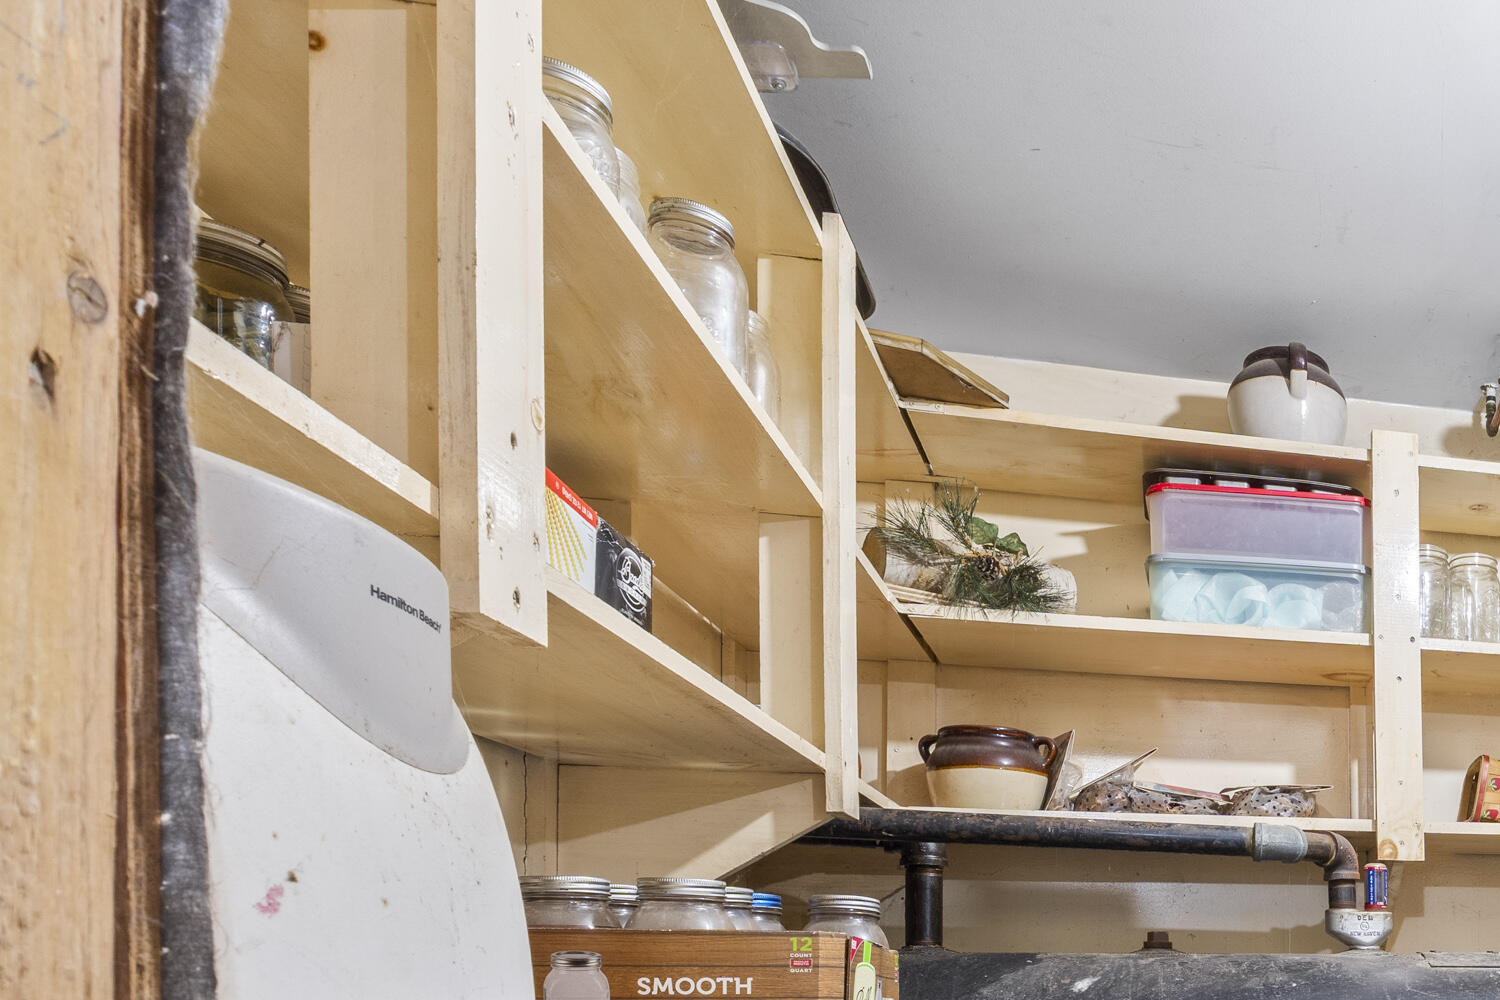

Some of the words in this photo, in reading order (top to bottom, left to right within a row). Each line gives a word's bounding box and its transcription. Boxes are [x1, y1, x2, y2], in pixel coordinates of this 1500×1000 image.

[370, 584, 419, 618] Hamilton
[419, 609, 441, 634] Beach
[789, 937, 812, 951] 12
[637, 977, 753, 995] SMOOTH
